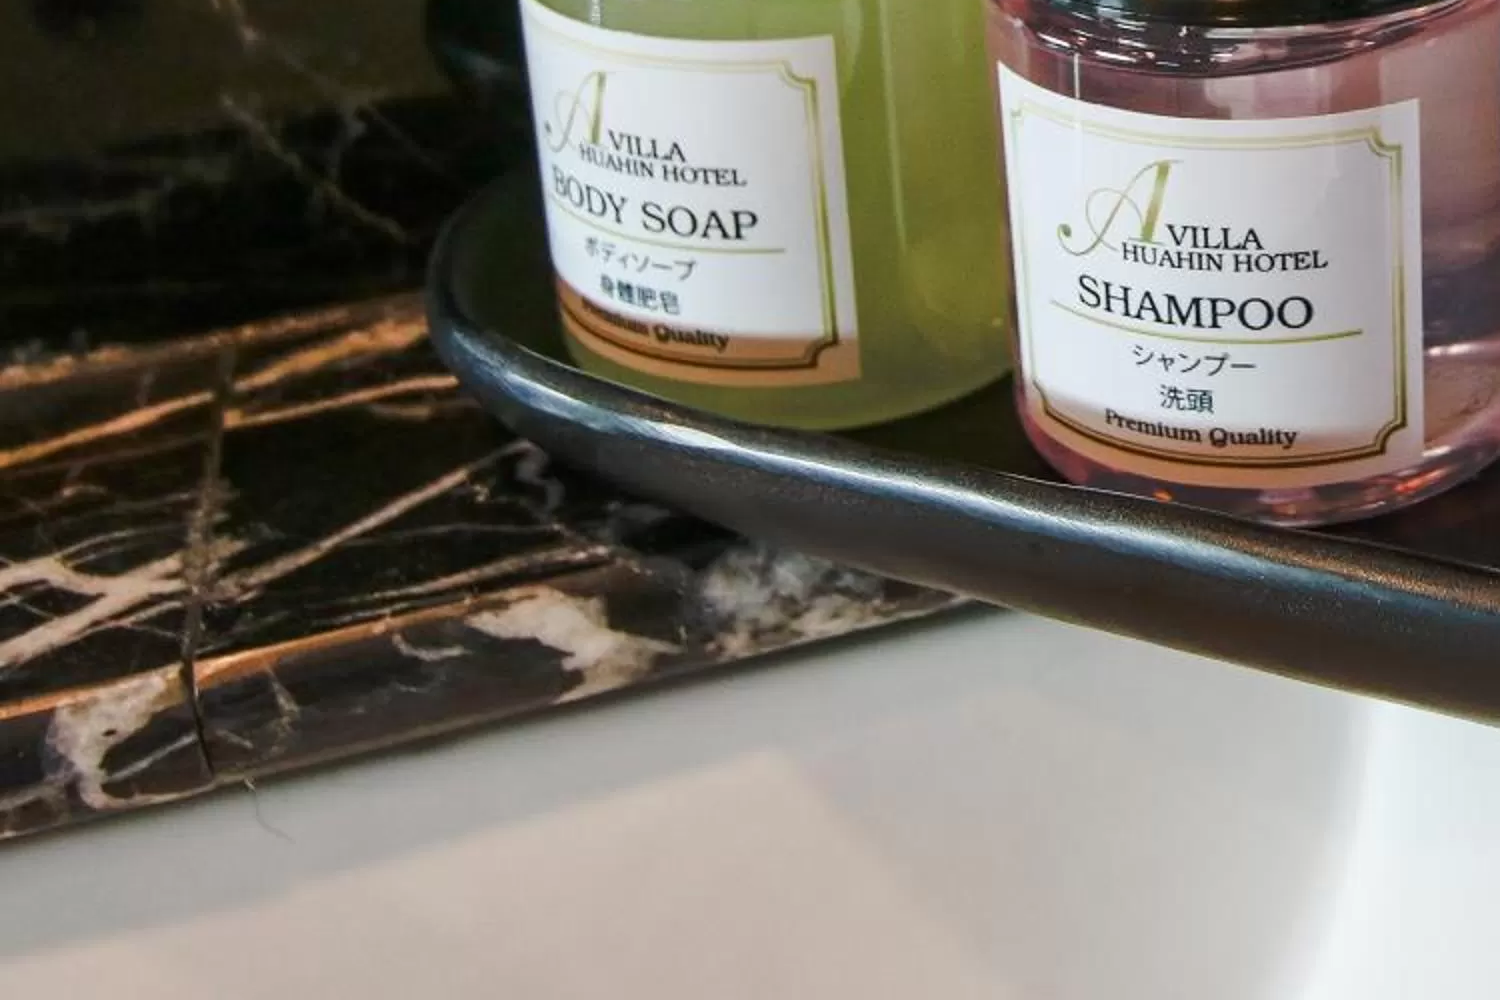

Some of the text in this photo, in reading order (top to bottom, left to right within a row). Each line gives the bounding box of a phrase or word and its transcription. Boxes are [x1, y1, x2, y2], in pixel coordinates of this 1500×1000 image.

[544, 71, 686, 162] A VILLA
[579, 143, 747, 186] HUAHIN HOTEL
[552, 164, 758, 241] BODY SOAP
[1056, 159, 1264, 256] A VILLA
[1122, 242, 1329, 273] HUAHIN HOTEL
[1078, 274, 1314, 331] SHAMPOO
[653, 322, 730, 350] Quality
[1132, 344, 1257, 377] シャンプー
[1159, 384, 1214, 414] 洗頭
[1104, 408, 1297, 449] Premium Quality
